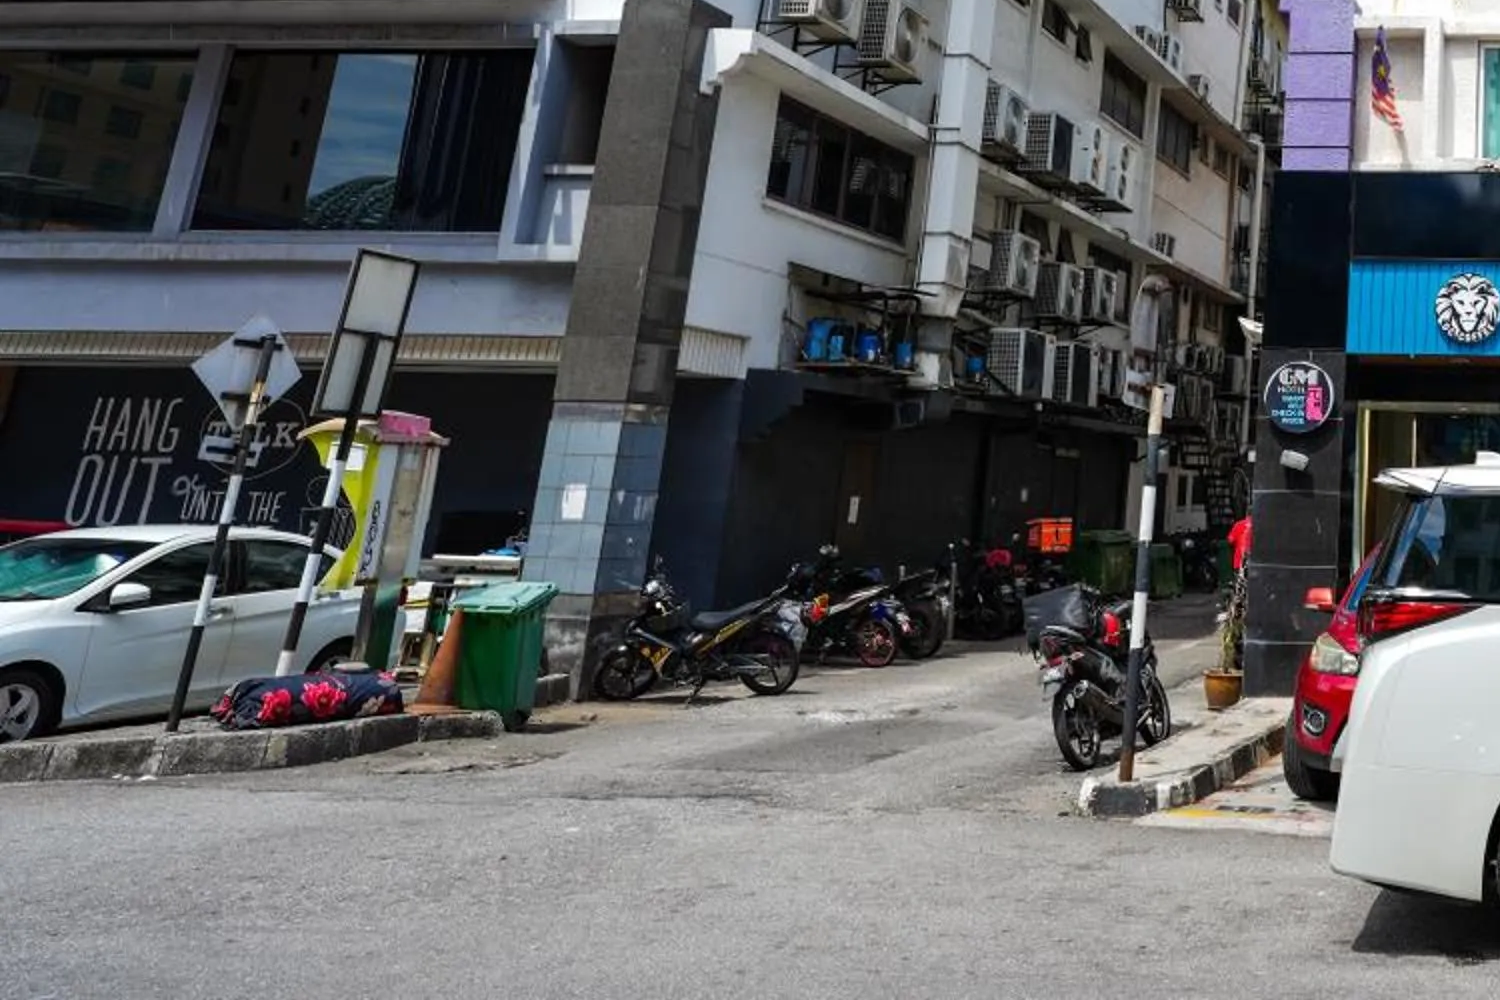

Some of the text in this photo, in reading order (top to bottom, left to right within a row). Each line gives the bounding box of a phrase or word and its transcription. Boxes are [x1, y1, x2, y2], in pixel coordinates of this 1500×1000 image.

[1279, 367, 1319, 387] GM
[82, 397, 184, 453] HANG
[206, 420, 300, 449] TLK
[64, 454, 173, 527] OUT
[172, 474, 287, 523] UNT THE
